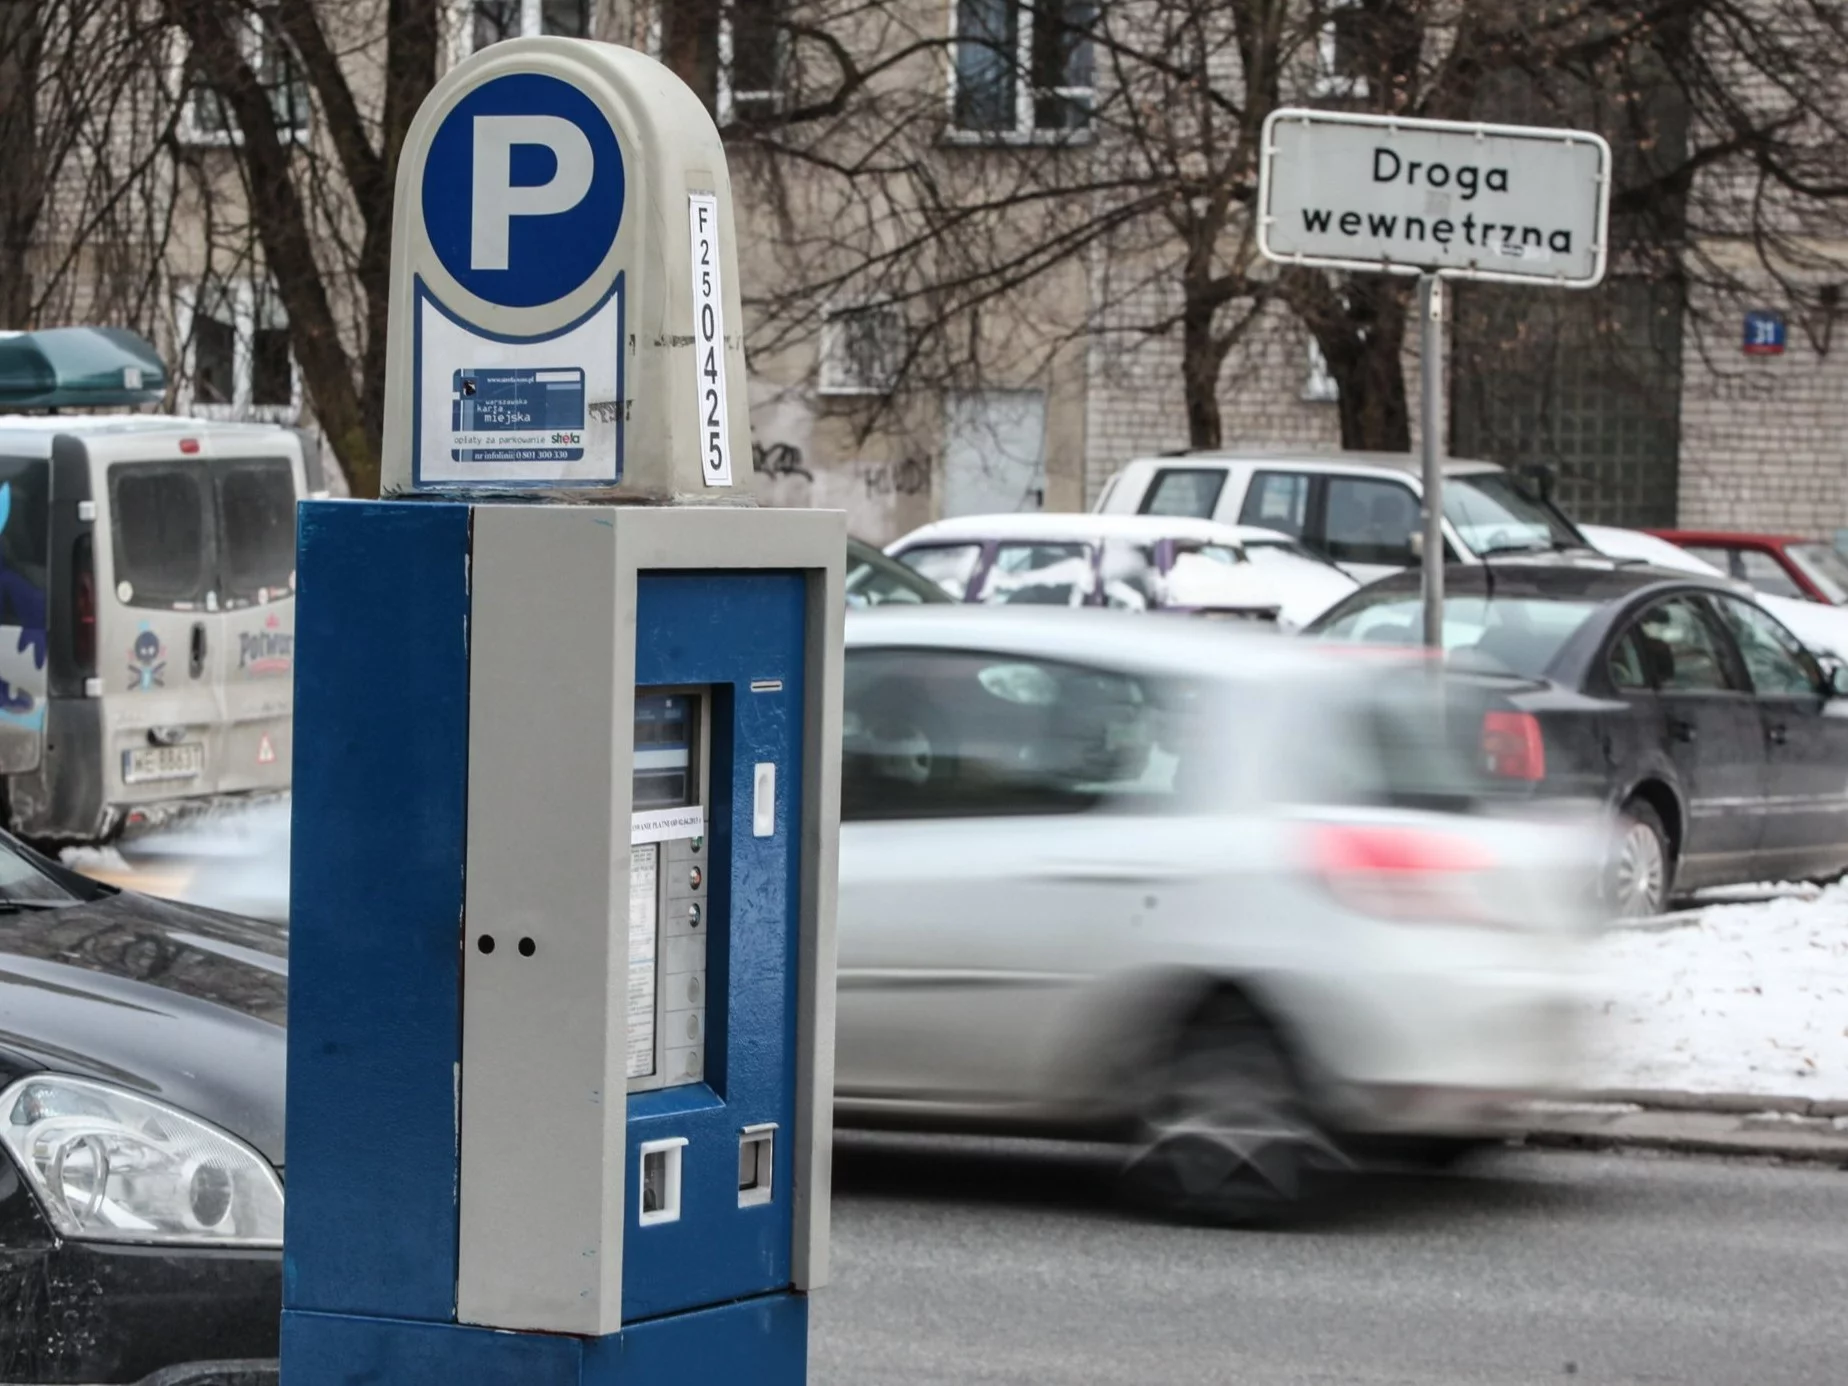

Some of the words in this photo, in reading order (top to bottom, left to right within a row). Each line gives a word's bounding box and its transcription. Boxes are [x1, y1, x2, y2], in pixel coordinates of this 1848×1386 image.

[1372, 147, 1509, 201] Droga
[471, 114, 595, 271] P
[476, 403, 504, 413] karta
[484, 411, 531, 425] miejska
[485, 436, 496, 444] za
[498, 435, 546, 445] parkowanie
[474, 452, 484, 460] nr
[522, 450, 536, 459] 801
[538, 450, 553, 459] 300
[553, 450, 568, 459] 330
